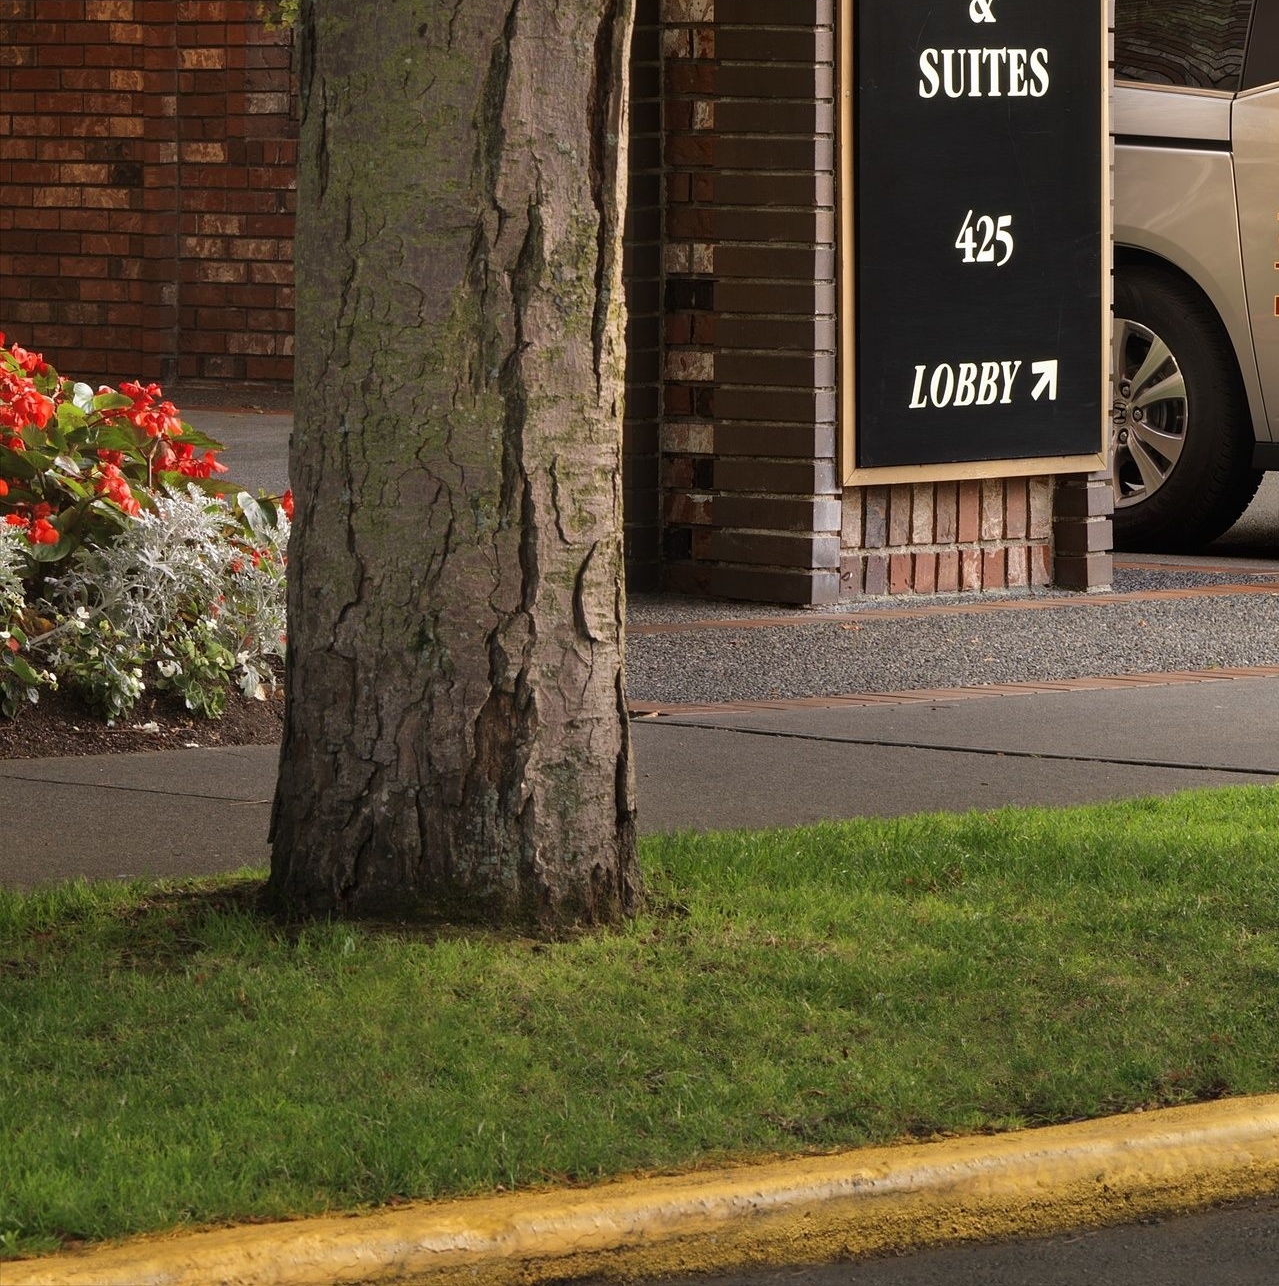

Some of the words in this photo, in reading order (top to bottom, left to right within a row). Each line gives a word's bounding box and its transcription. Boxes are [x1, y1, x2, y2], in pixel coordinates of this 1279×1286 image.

[918, 46, 1050, 99] SUITES
[954, 209, 1014, 267] 425
[908, 360, 1023, 409] LOBBY
